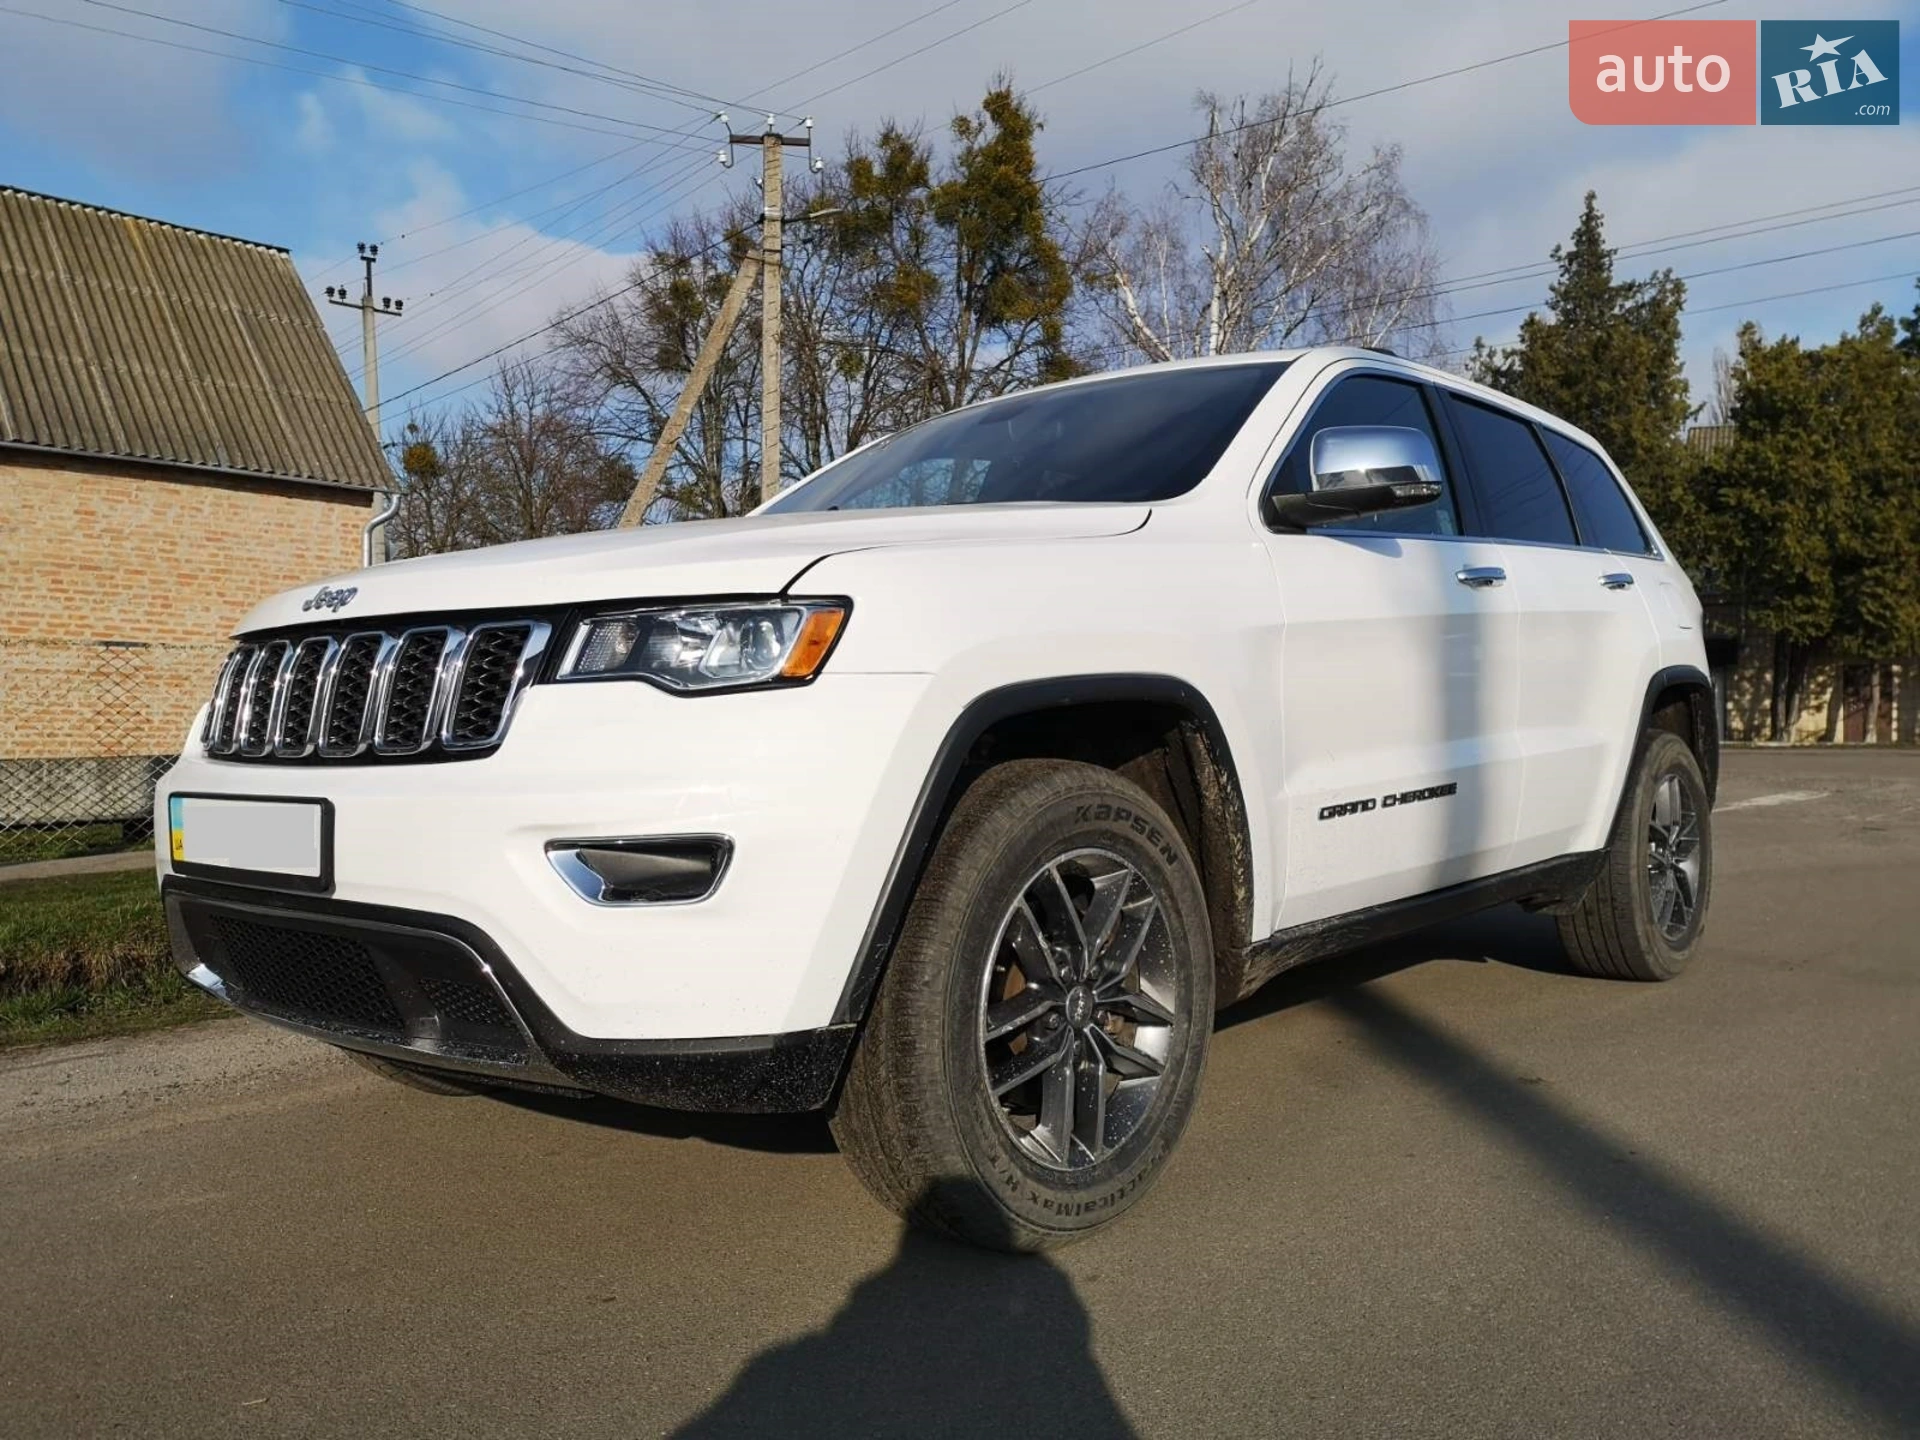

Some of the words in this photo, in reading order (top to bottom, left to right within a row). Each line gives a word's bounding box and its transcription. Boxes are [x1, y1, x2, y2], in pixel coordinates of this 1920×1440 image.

[302, 586, 358, 613] Jeep
[1318, 798, 1376, 820] GRAND
[1381, 782, 1457, 808] CHEROKEE
